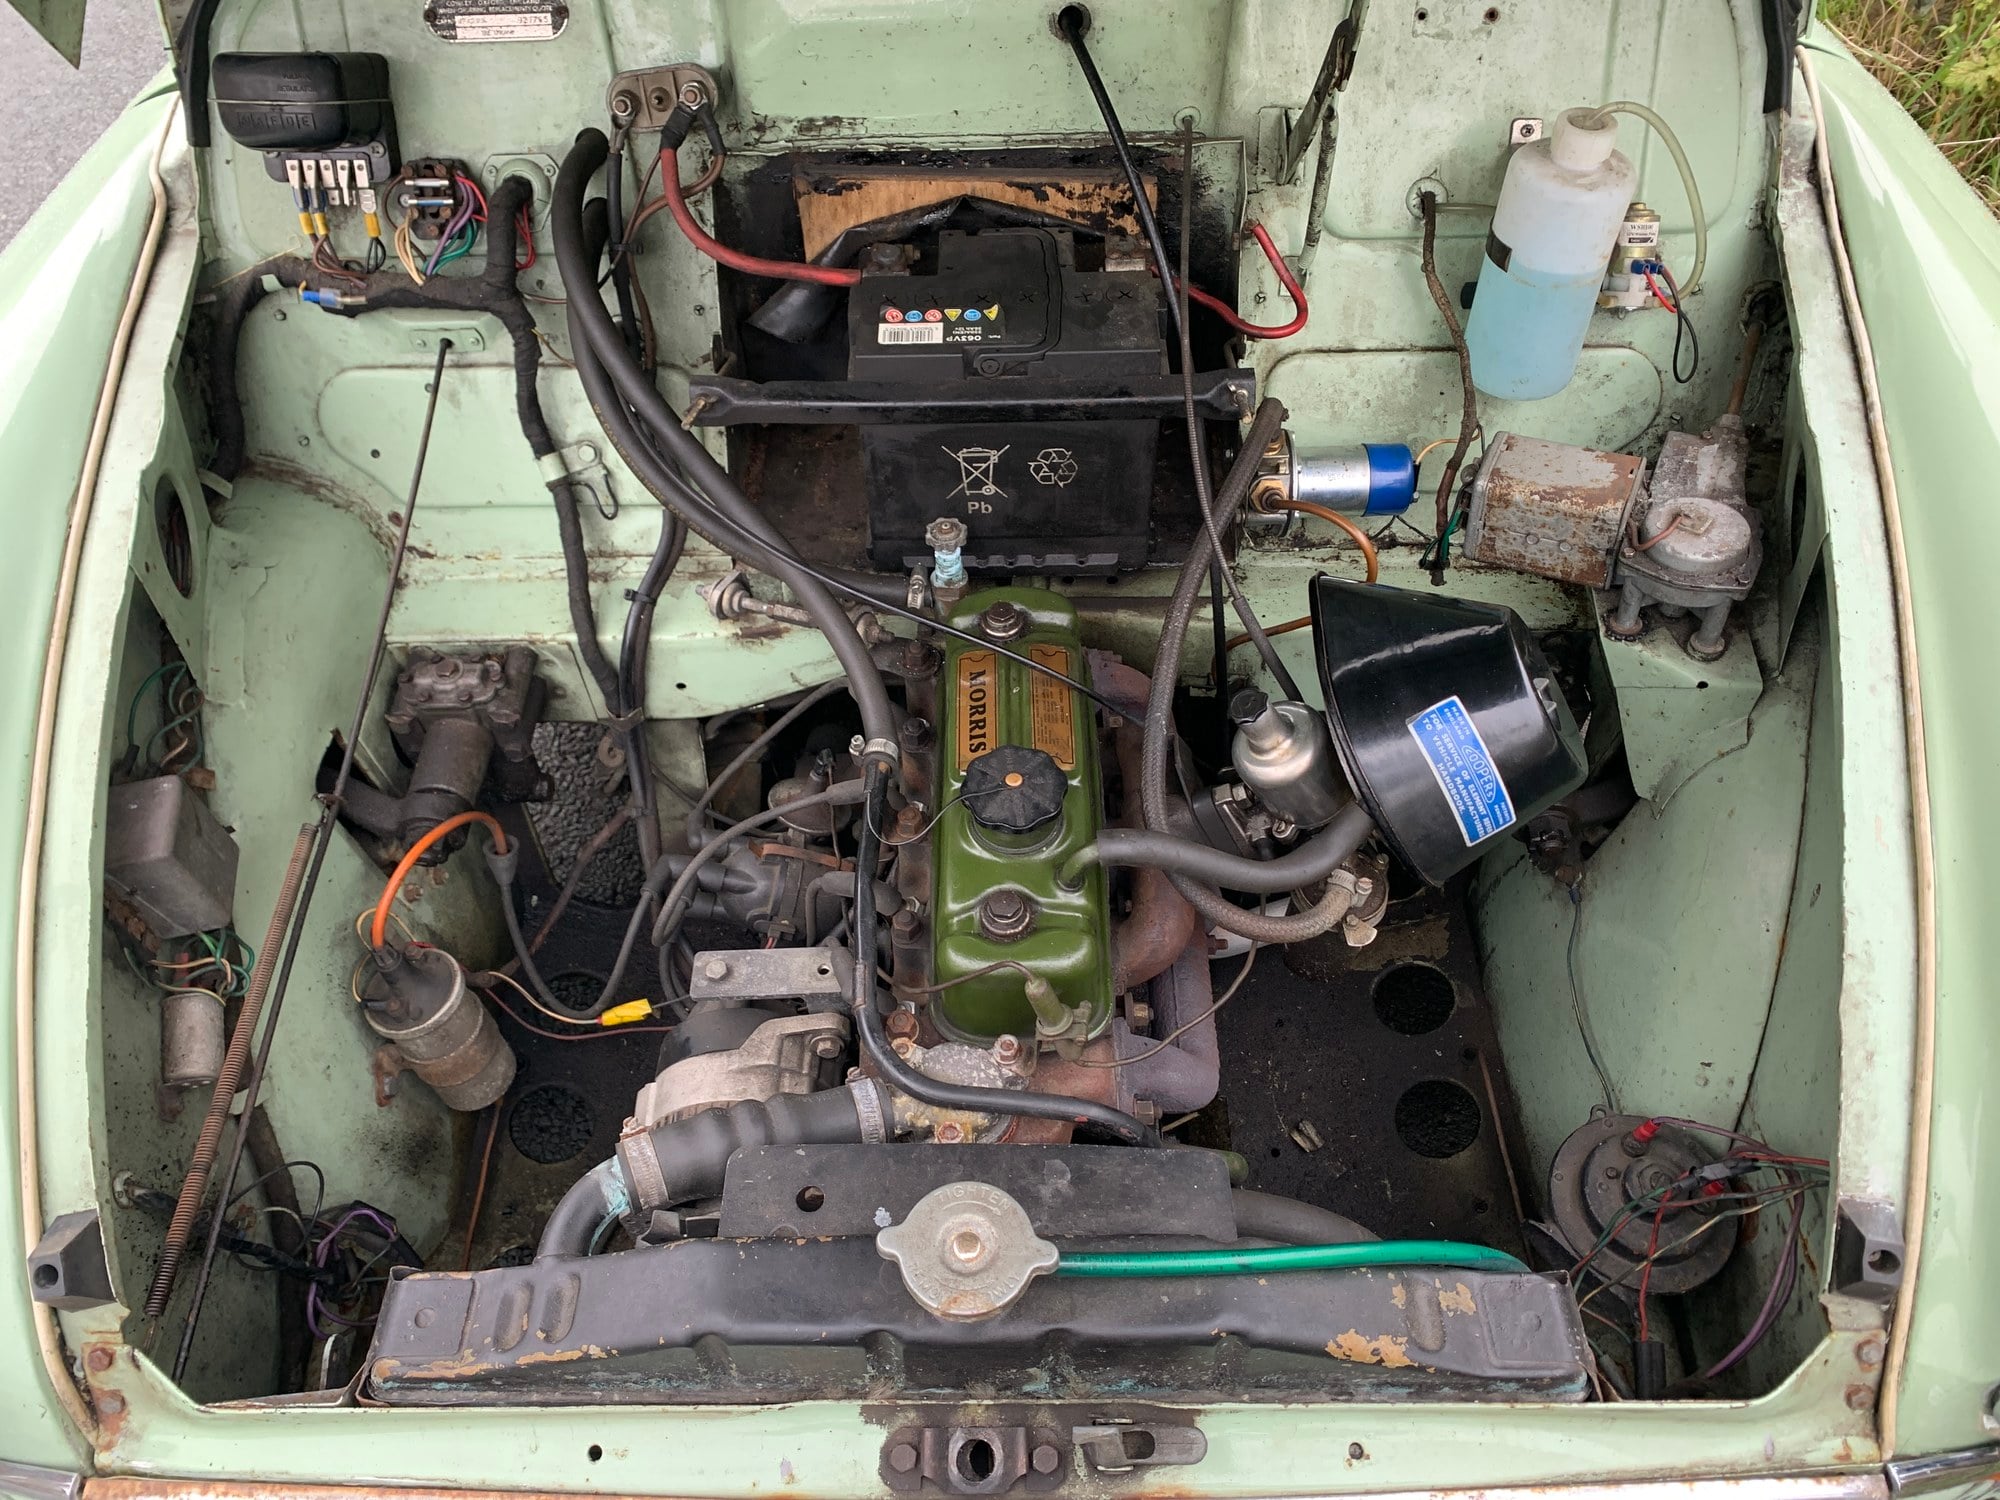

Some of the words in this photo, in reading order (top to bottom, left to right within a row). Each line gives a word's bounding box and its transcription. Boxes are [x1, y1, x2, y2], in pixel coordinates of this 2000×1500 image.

[644, 478, 666, 501] HOSE
[968, 501, 993, 514] Pb
[969, 669, 987, 753] MORRIS
[1443, 708, 1465, 740] ENGLAND
[1450, 706, 1465, 726] MADE
[1464, 726, 1471, 736] IN
[1422, 719, 1433, 731] TO
[1431, 735, 1457, 774] VEHICLE
[1454, 777, 1486, 839] MANUFACTURERS
[1430, 713, 1443, 732] FOR
[1441, 733, 1463, 767] SERVICE
[1461, 769, 1471, 783] OF
[1468, 783, 1487, 816] ELEMENT
[1482, 816, 1494, 835] REFER
[1436, 763, 1465, 814] HANDBOOK.
[1464, 748, 1494, 799] COOPERS
[934, 1184, 1013, 1210] TIGHTEN
